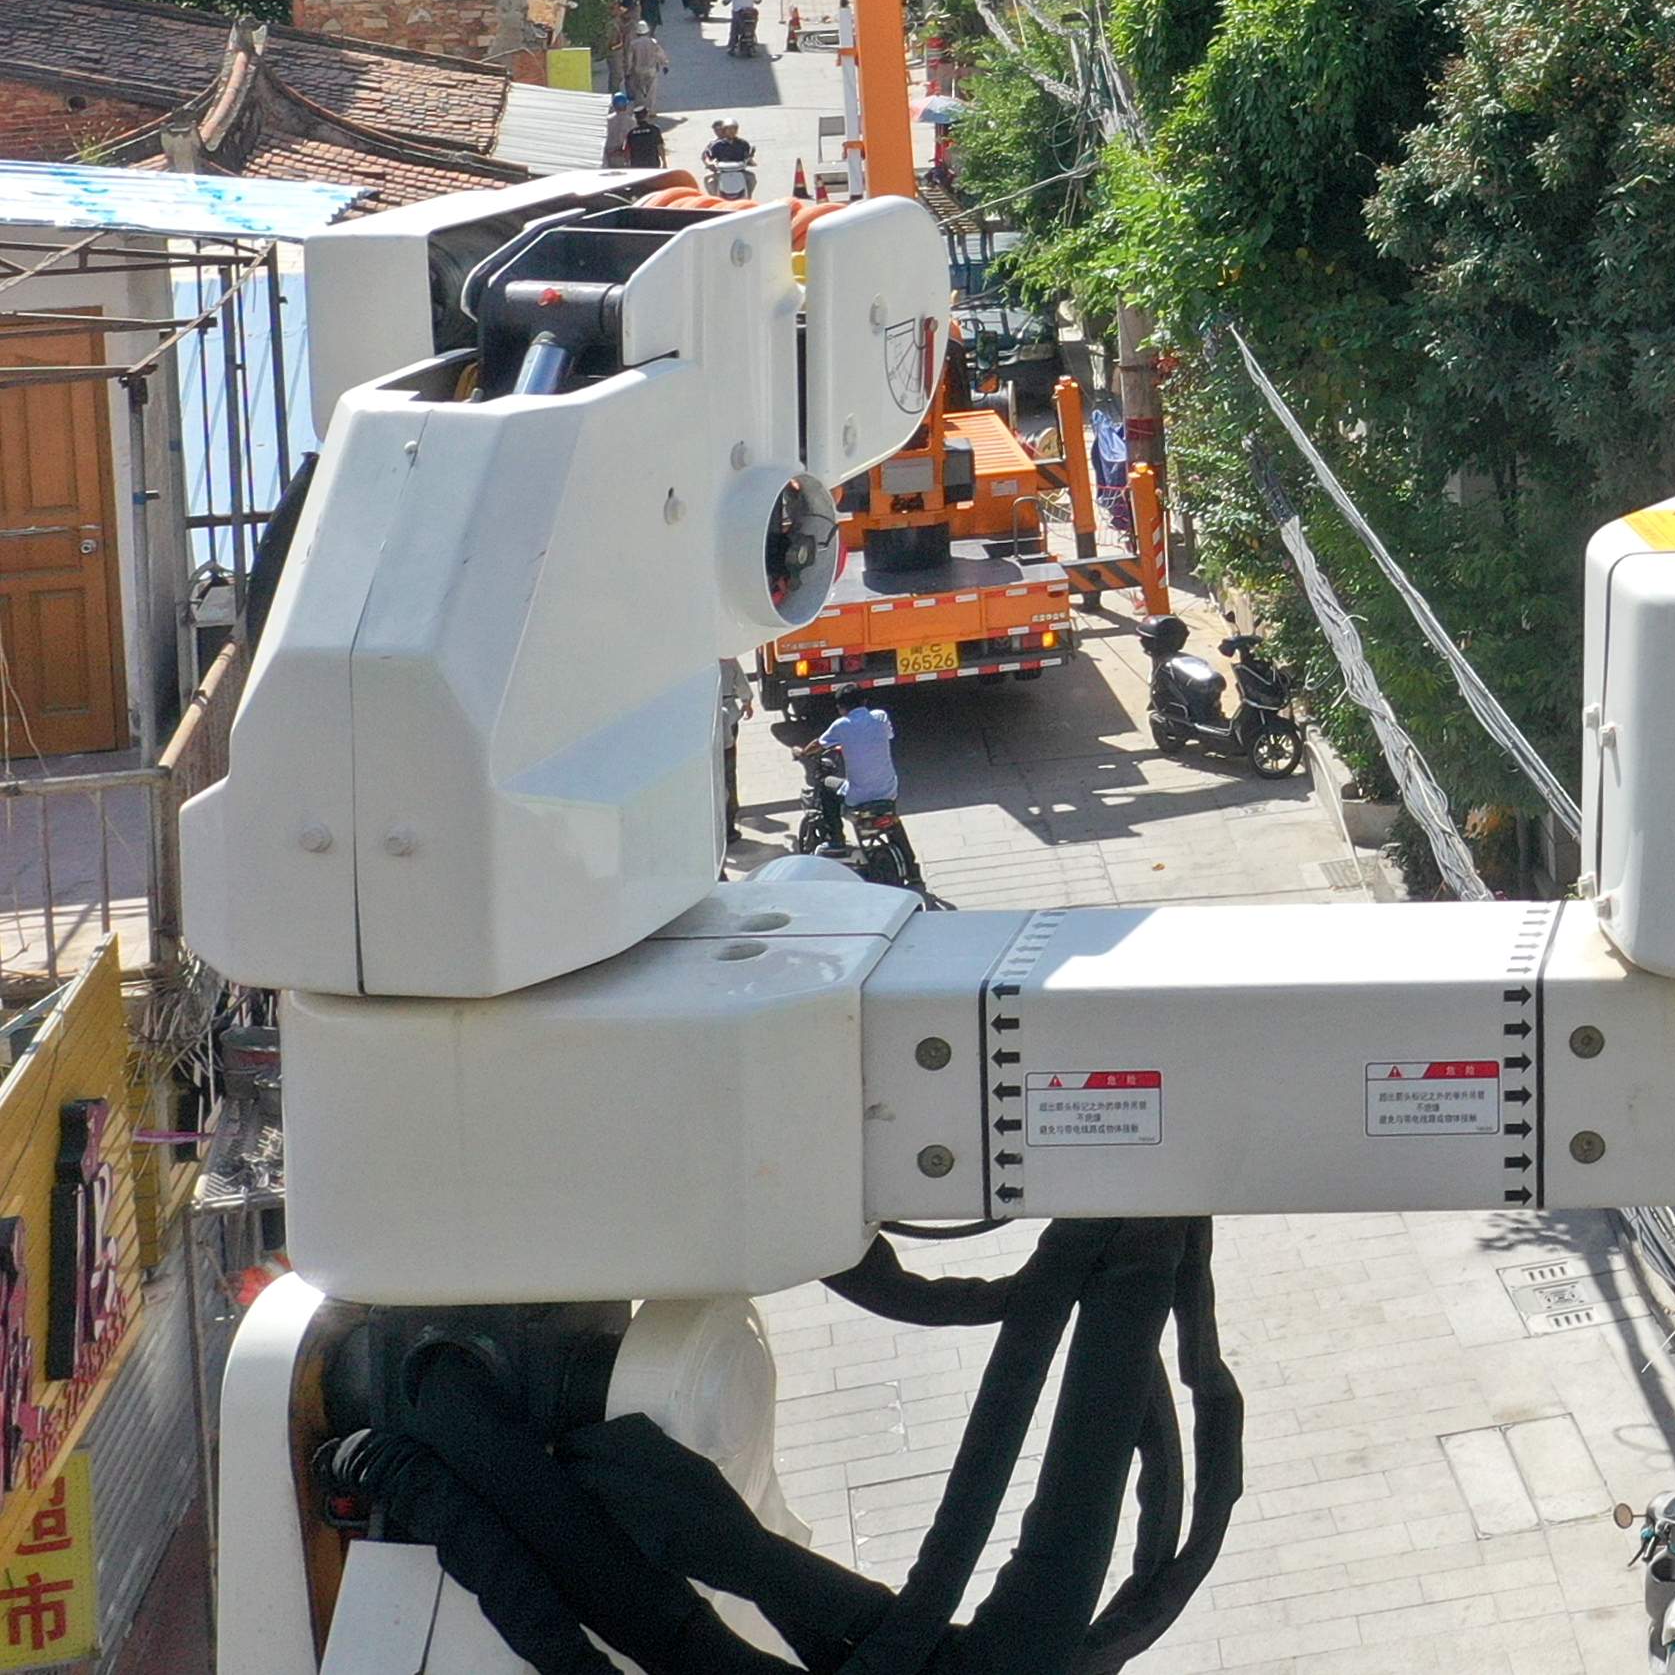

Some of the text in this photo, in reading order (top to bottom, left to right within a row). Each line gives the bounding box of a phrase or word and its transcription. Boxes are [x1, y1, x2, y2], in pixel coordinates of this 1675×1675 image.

[900, 653, 955, 672] 96526
[1445, 1065, 1475, 1077] 危险
[1106, 1074, 1137, 1086] 危险
